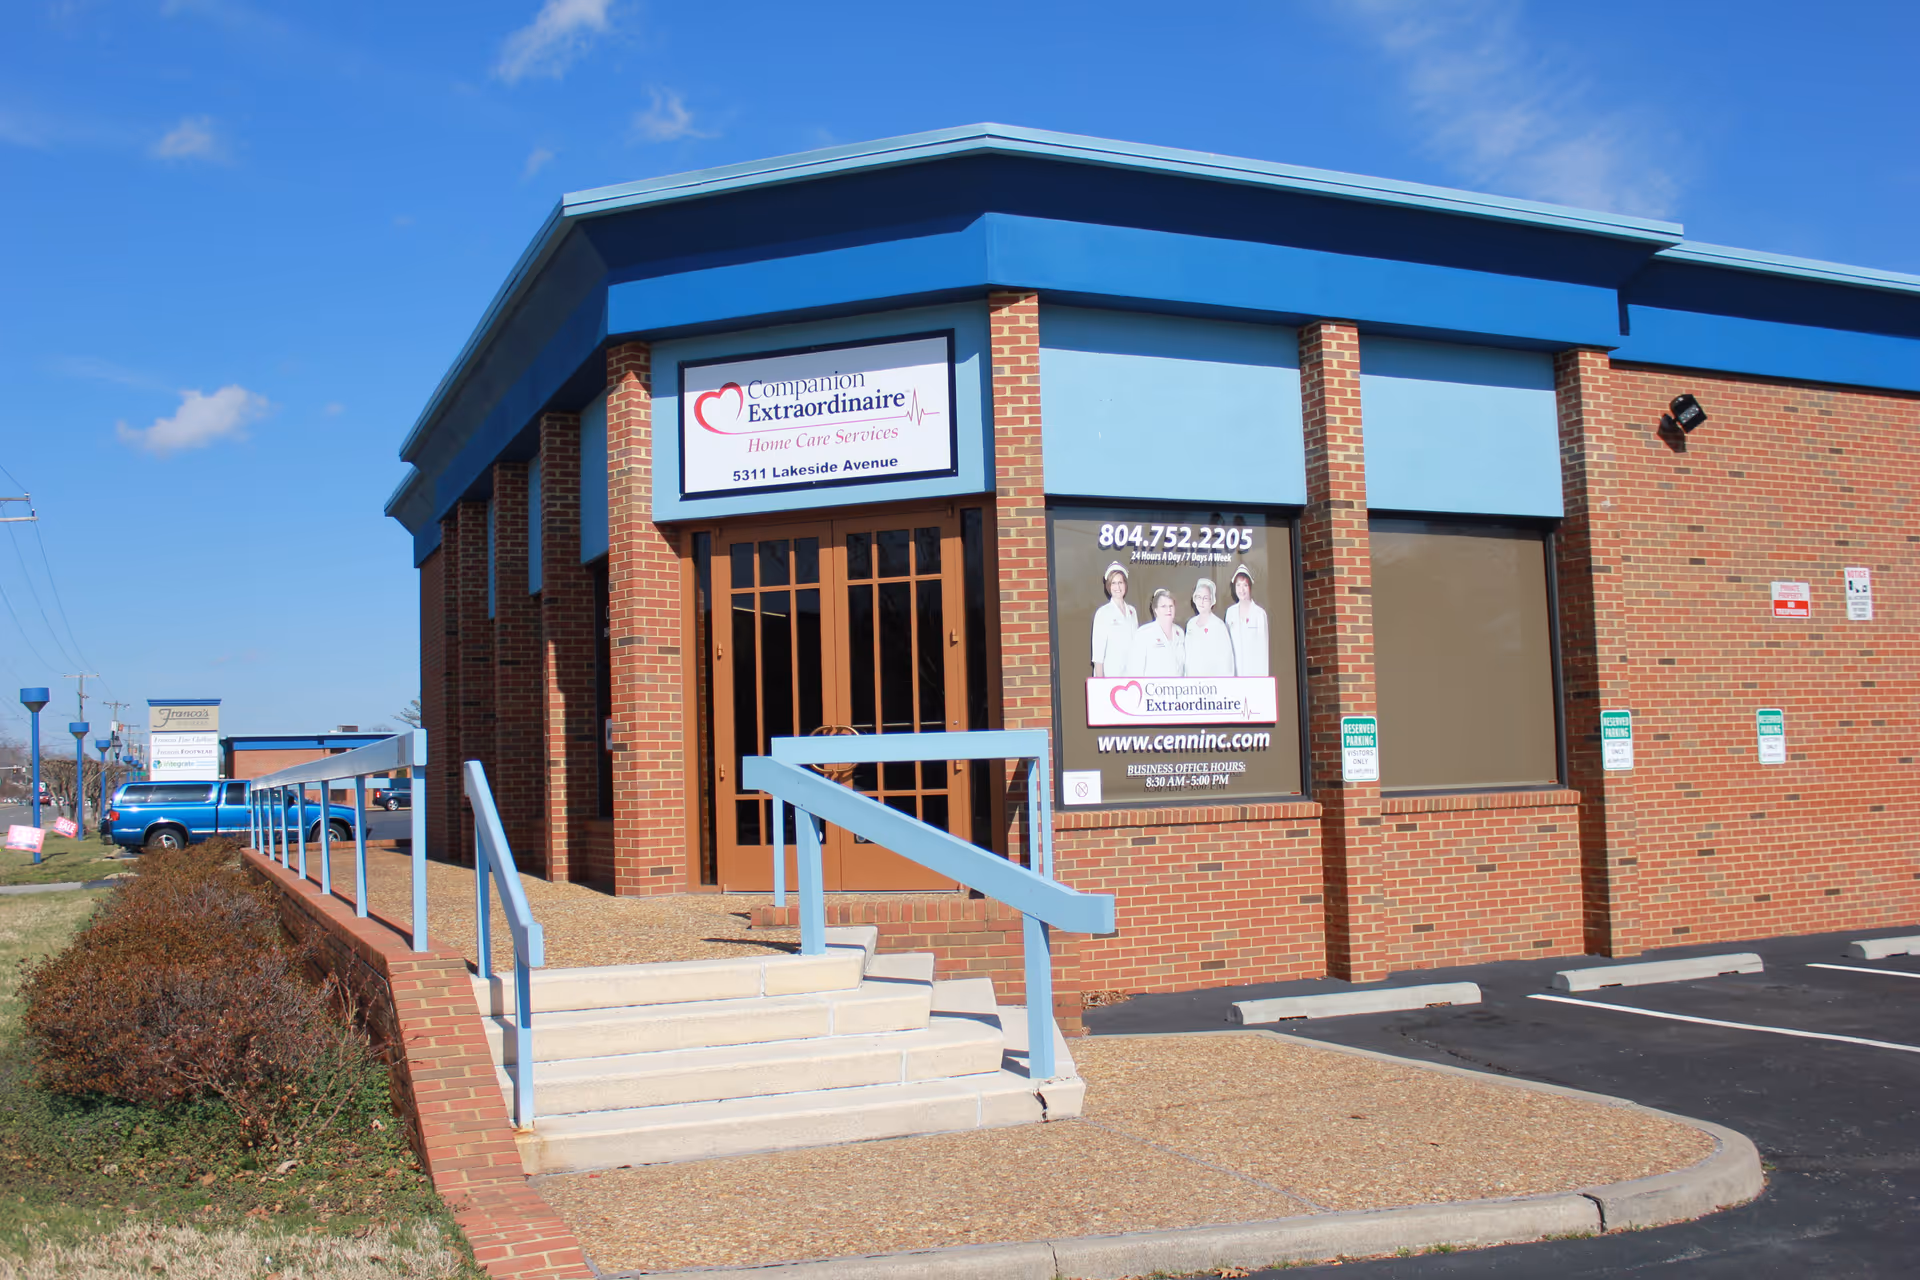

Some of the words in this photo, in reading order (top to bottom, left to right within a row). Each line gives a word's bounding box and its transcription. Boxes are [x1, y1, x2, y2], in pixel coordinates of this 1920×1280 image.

[747, 371, 866, 400] Companion
[748, 389, 906, 423] Extraordinaire
[747, 436, 792, 453] Home
[796, 433, 831, 449] Care
[835, 425, 899, 445] Services
[732, 468, 767, 482] 5311
[772, 461, 838, 479] Lakeside
[842, 456, 899, 472] Avenue
[1099, 523, 1253, 550] 804.752.2205
[1130, 551, 1141, 560] 24
[1141, 551, 1161, 561] Hours
[1161, 552, 1167, 561] A
[1168, 552, 1181, 563] Day
[1191, 552, 1207, 563] Days
[1207, 553, 1213, 562] A
[1213, 553, 1232, 562] Week
[1145, 681, 1218, 699] Companion
[1146, 697, 1241, 712] Extraordinaire
[153, 708, 210, 728] Franco's
[1343, 723, 1375, 734] RESERVED
[1098, 729, 1270, 752] www.cenninc.com
[1345, 735, 1374, 746] PARKING
[1346, 749, 1374, 757] VISITORS
[1127, 764, 1174, 775] BUSINESS
[1175, 762, 1209, 773] OFFICE
[1210, 761, 1246, 773] HOURS:
[1145, 776, 1165, 788] 8:30
[1211, 774, 1229, 785] PM
[59, 821, 76, 834] SALE
